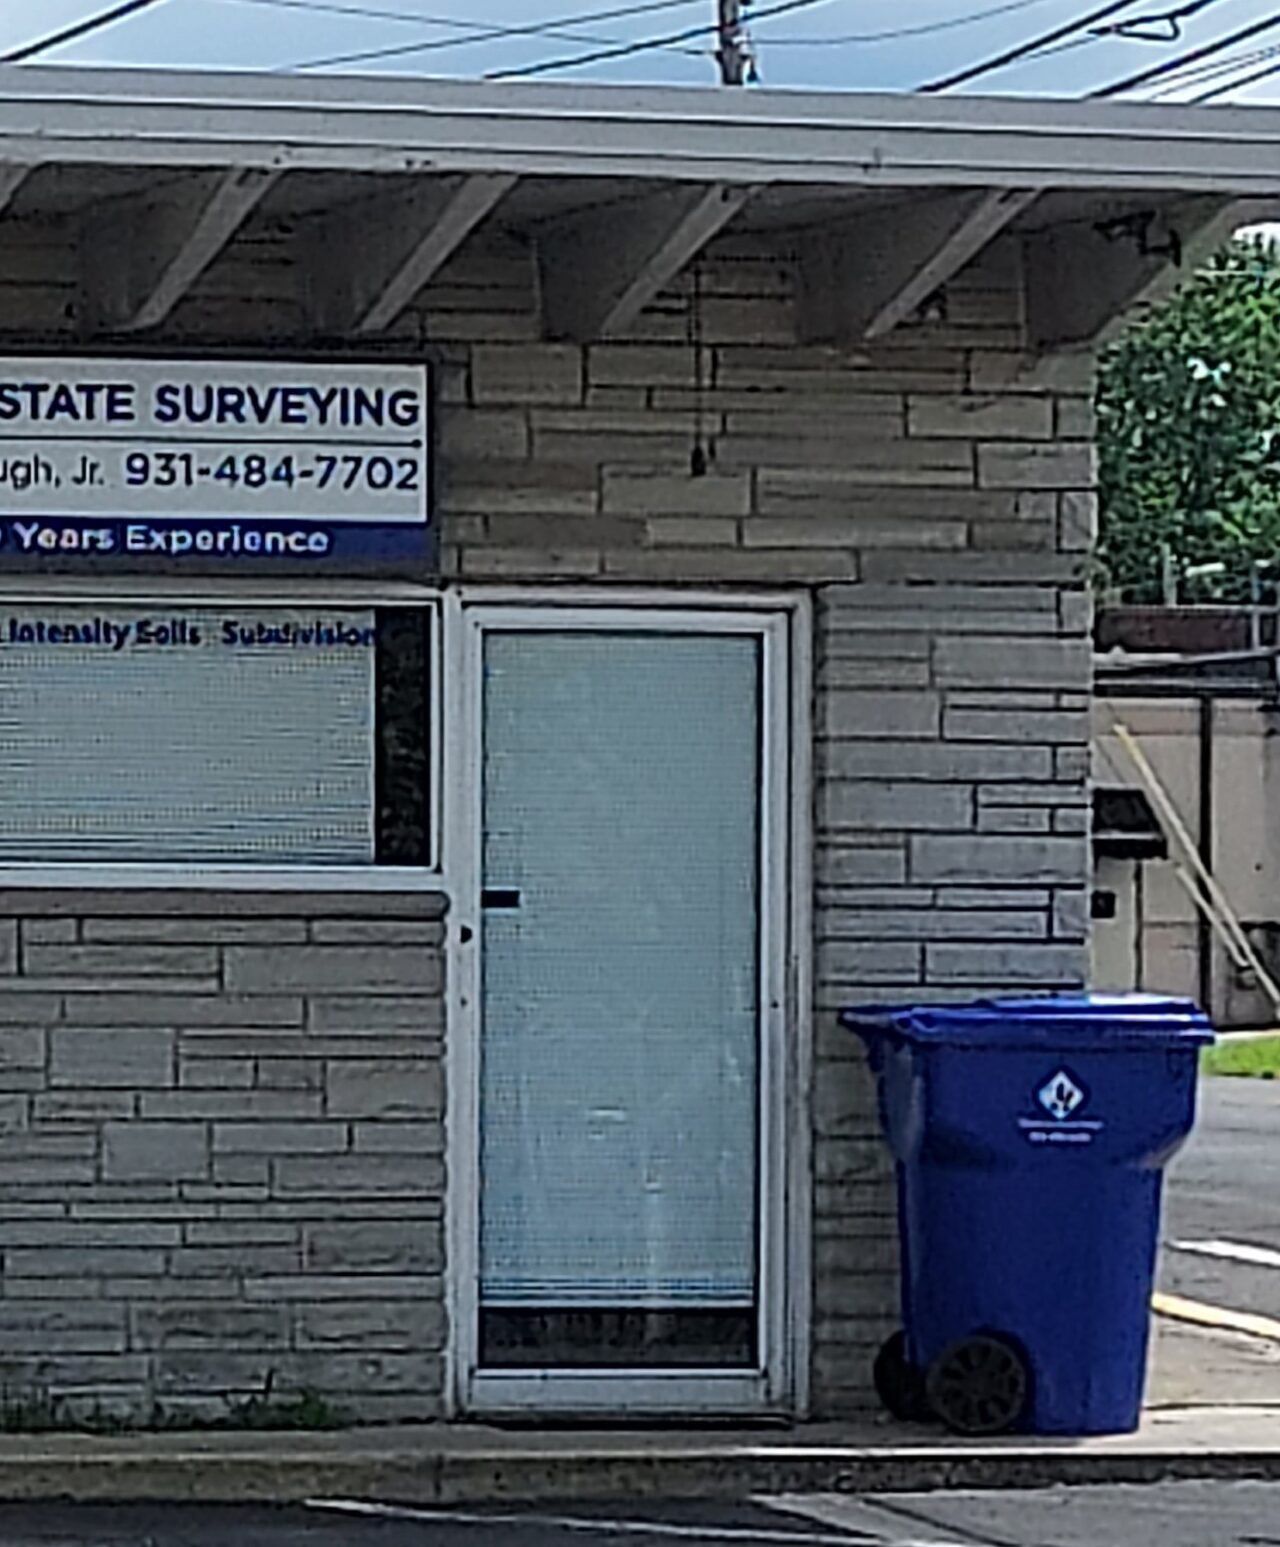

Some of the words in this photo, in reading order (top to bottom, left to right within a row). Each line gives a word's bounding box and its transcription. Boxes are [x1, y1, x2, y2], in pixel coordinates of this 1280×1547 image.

[153, 384, 421, 427] SURVEYING
[71, 455, 105, 486] Jr.
[125, 452, 420, 491] 931-484-7702
[13, 523, 114, 551] Years
[126, 525, 330, 553] Experience
[9, 617, 131, 650] Intensity
[135, 620, 201, 645] Soils
